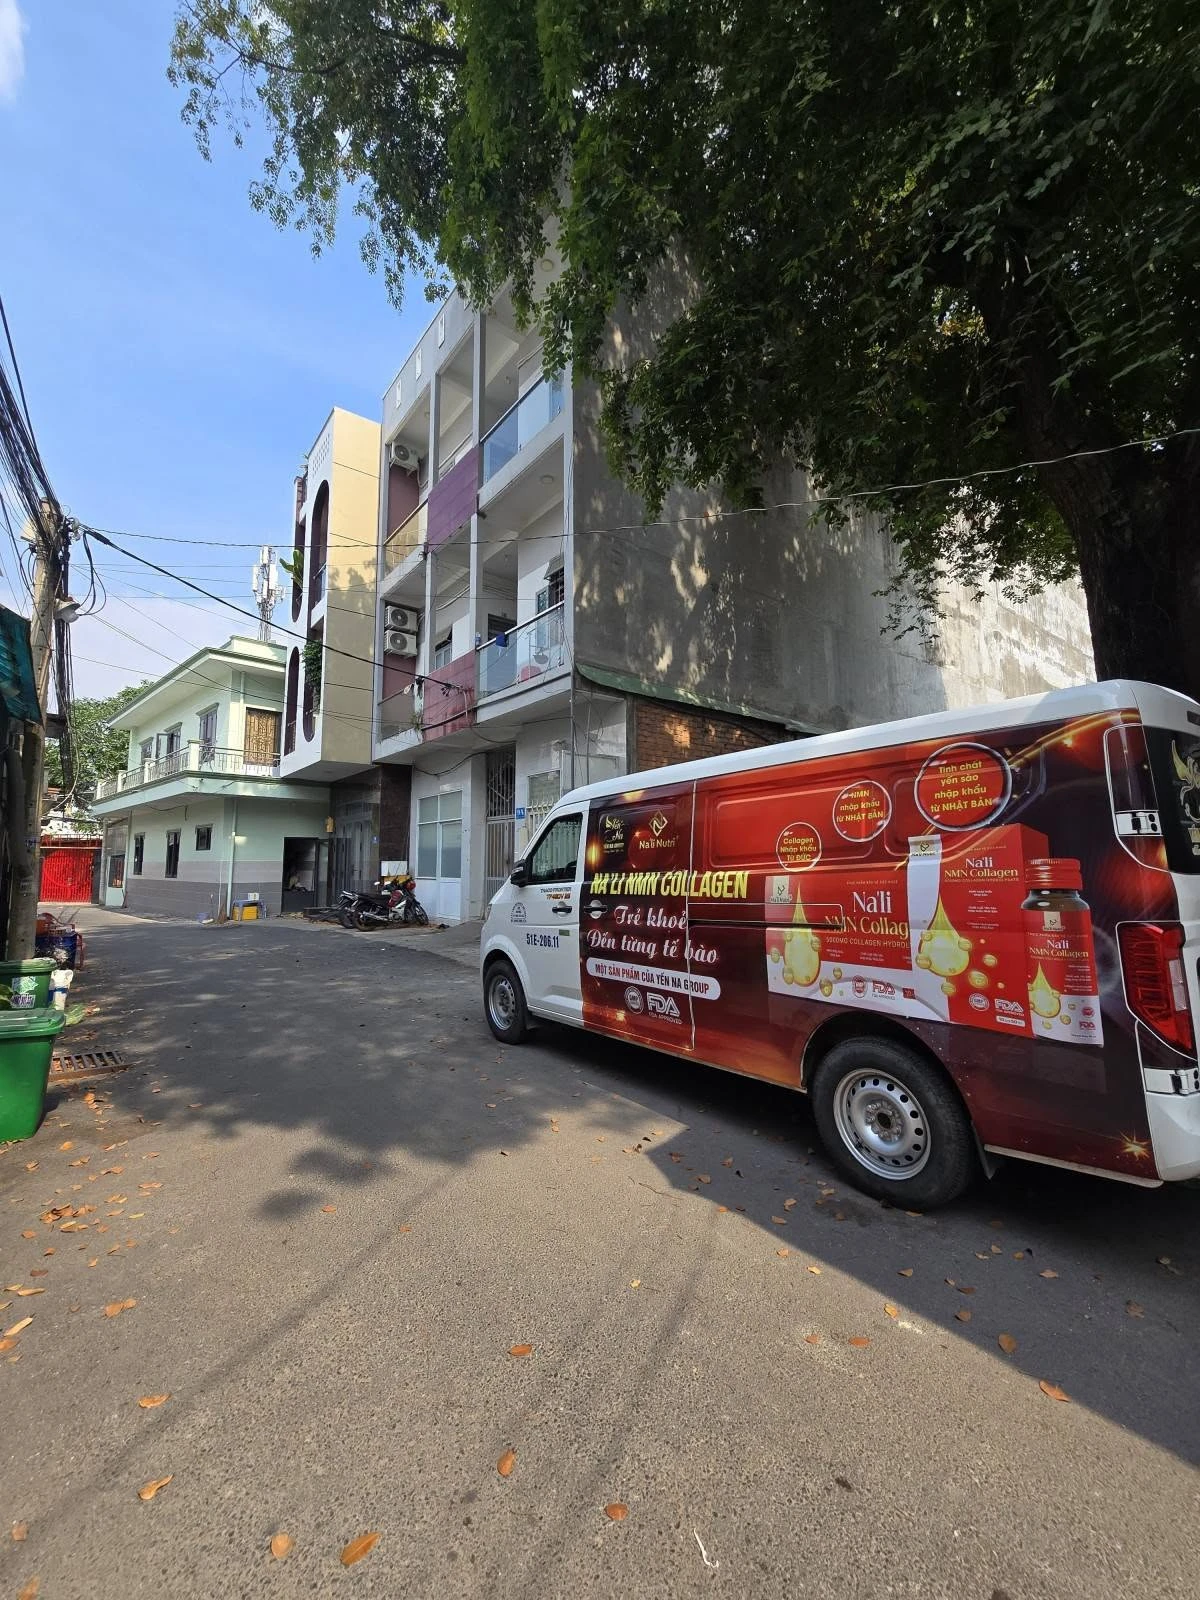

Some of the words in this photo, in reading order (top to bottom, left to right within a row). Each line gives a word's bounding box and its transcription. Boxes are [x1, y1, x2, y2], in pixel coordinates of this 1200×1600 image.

[960, 761, 982, 771] chất
[940, 775, 958, 786] yến
[960, 774, 979, 783] sào
[851, 790, 870, 799] NMN
[934, 789, 959, 799] nhập
[961, 784, 987, 796] khẩu
[840, 803, 859, 811] nhập
[860, 798, 880, 809] khẩu
[930, 803, 941, 813] từ
[942, 800, 968, 812] NHẬT
[970, 796, 993, 808] BẢN
[845, 813, 866, 823] NHẬT
[868, 809, 884, 820] BẢN
[783, 837, 814, 845] Collagen
[944, 869, 967, 878] NMN
[970, 868, 1018, 879] Collagen
[590, 873, 626, 895] NA'LI
[624, 872, 661, 896] NMN
[661, 869, 750, 899] COLLAGEN
[852, 890, 893, 914] Na'li
[614, 905, 641, 927] Trẻ
[646, 907, 688, 930] khoẻ
[860, 916, 909, 940] Collag
[526, 933, 559, 949] 51E-206.11
[587, 929, 616, 950] Đến
[621, 934, 658, 960] từng
[663, 937, 680, 958] tế
[684, 939, 719, 964] bào
[849, 938, 881, 947] COLLAGEN
[883, 939, 910, 949] HYDROL
[1029, 947, 1050, 957] NMN
[1051, 948, 1089, 959] Collagen
[595, 963, 607, 977] MỘT
[608, 963, 621, 977] SẢN
[622, 966, 640, 981] PHẨM
[641, 968, 655, 984] CỦA
[656, 972, 670, 986] YẾN
[671, 978, 682, 989] NA
[683, 981, 710, 995] GROUP
[872, 980, 896, 996] FDA
[646, 992, 681, 1017] FDA
[994, 998, 1024, 1013] FDA
